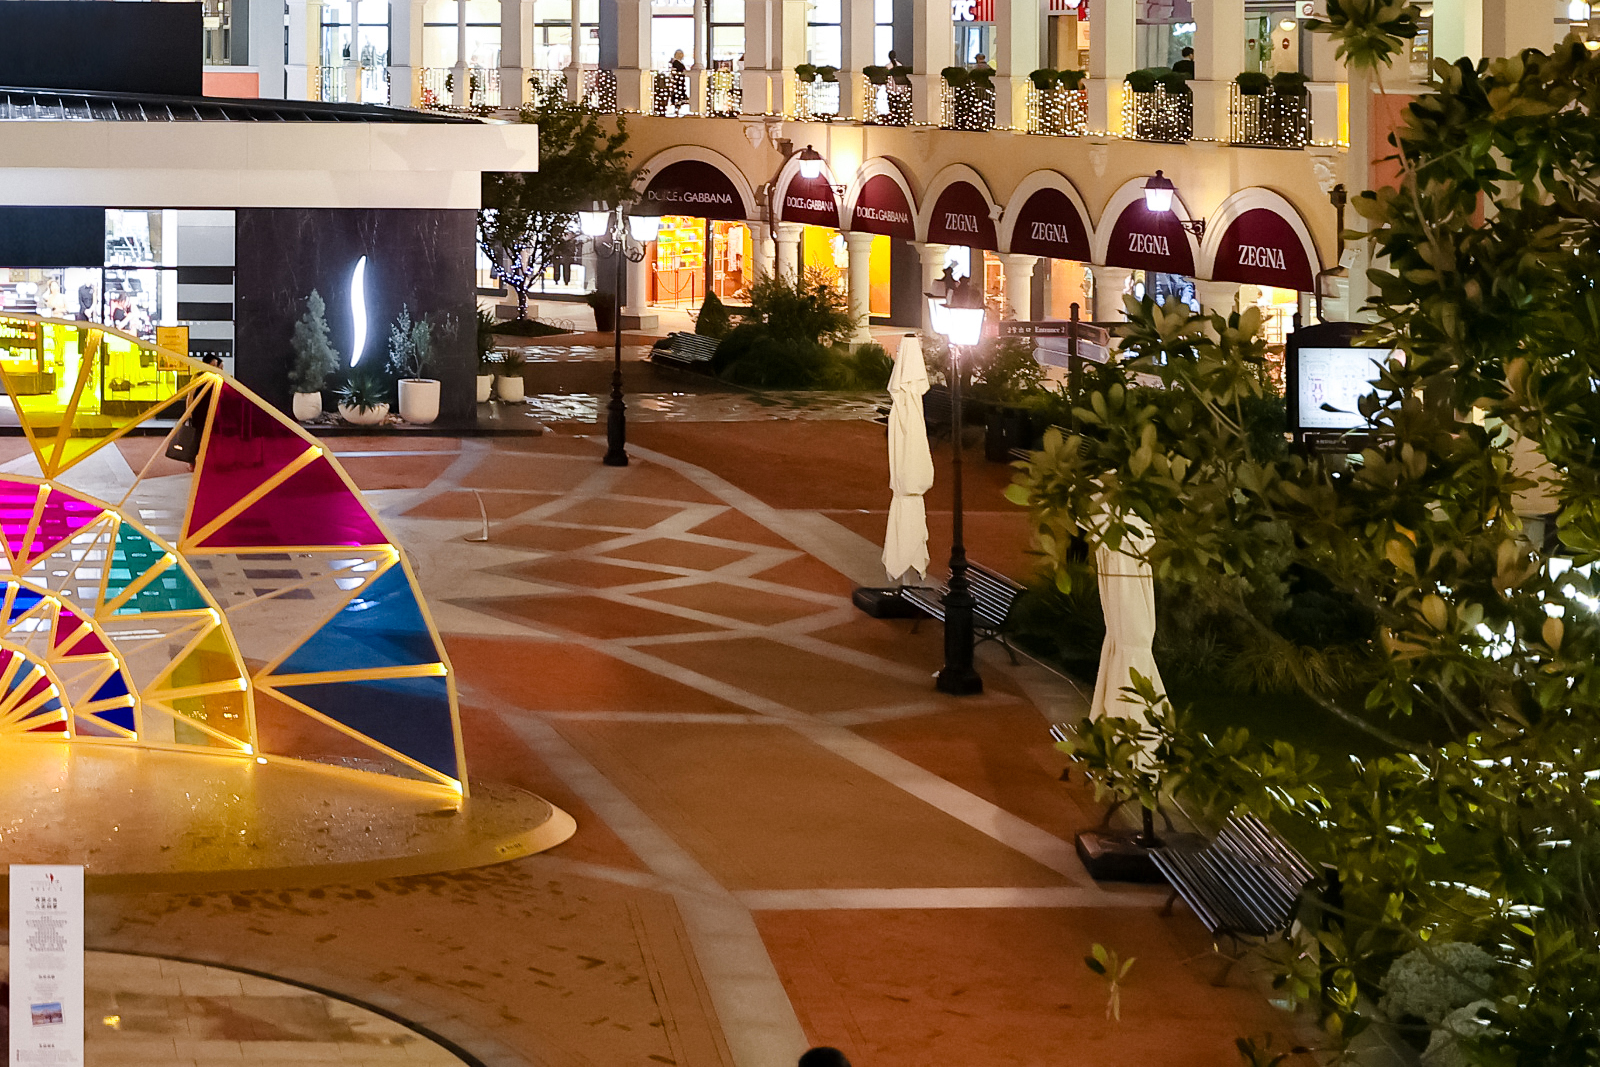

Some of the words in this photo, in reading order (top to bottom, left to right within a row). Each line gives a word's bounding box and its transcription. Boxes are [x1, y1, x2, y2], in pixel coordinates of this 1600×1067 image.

[945, 212, 979, 233] ZEGNA
[1031, 221, 1069, 244] ZEGNA
[1128, 232, 1171, 256] ZEGNA
[1238, 244, 1287, 270] ZEGNA
